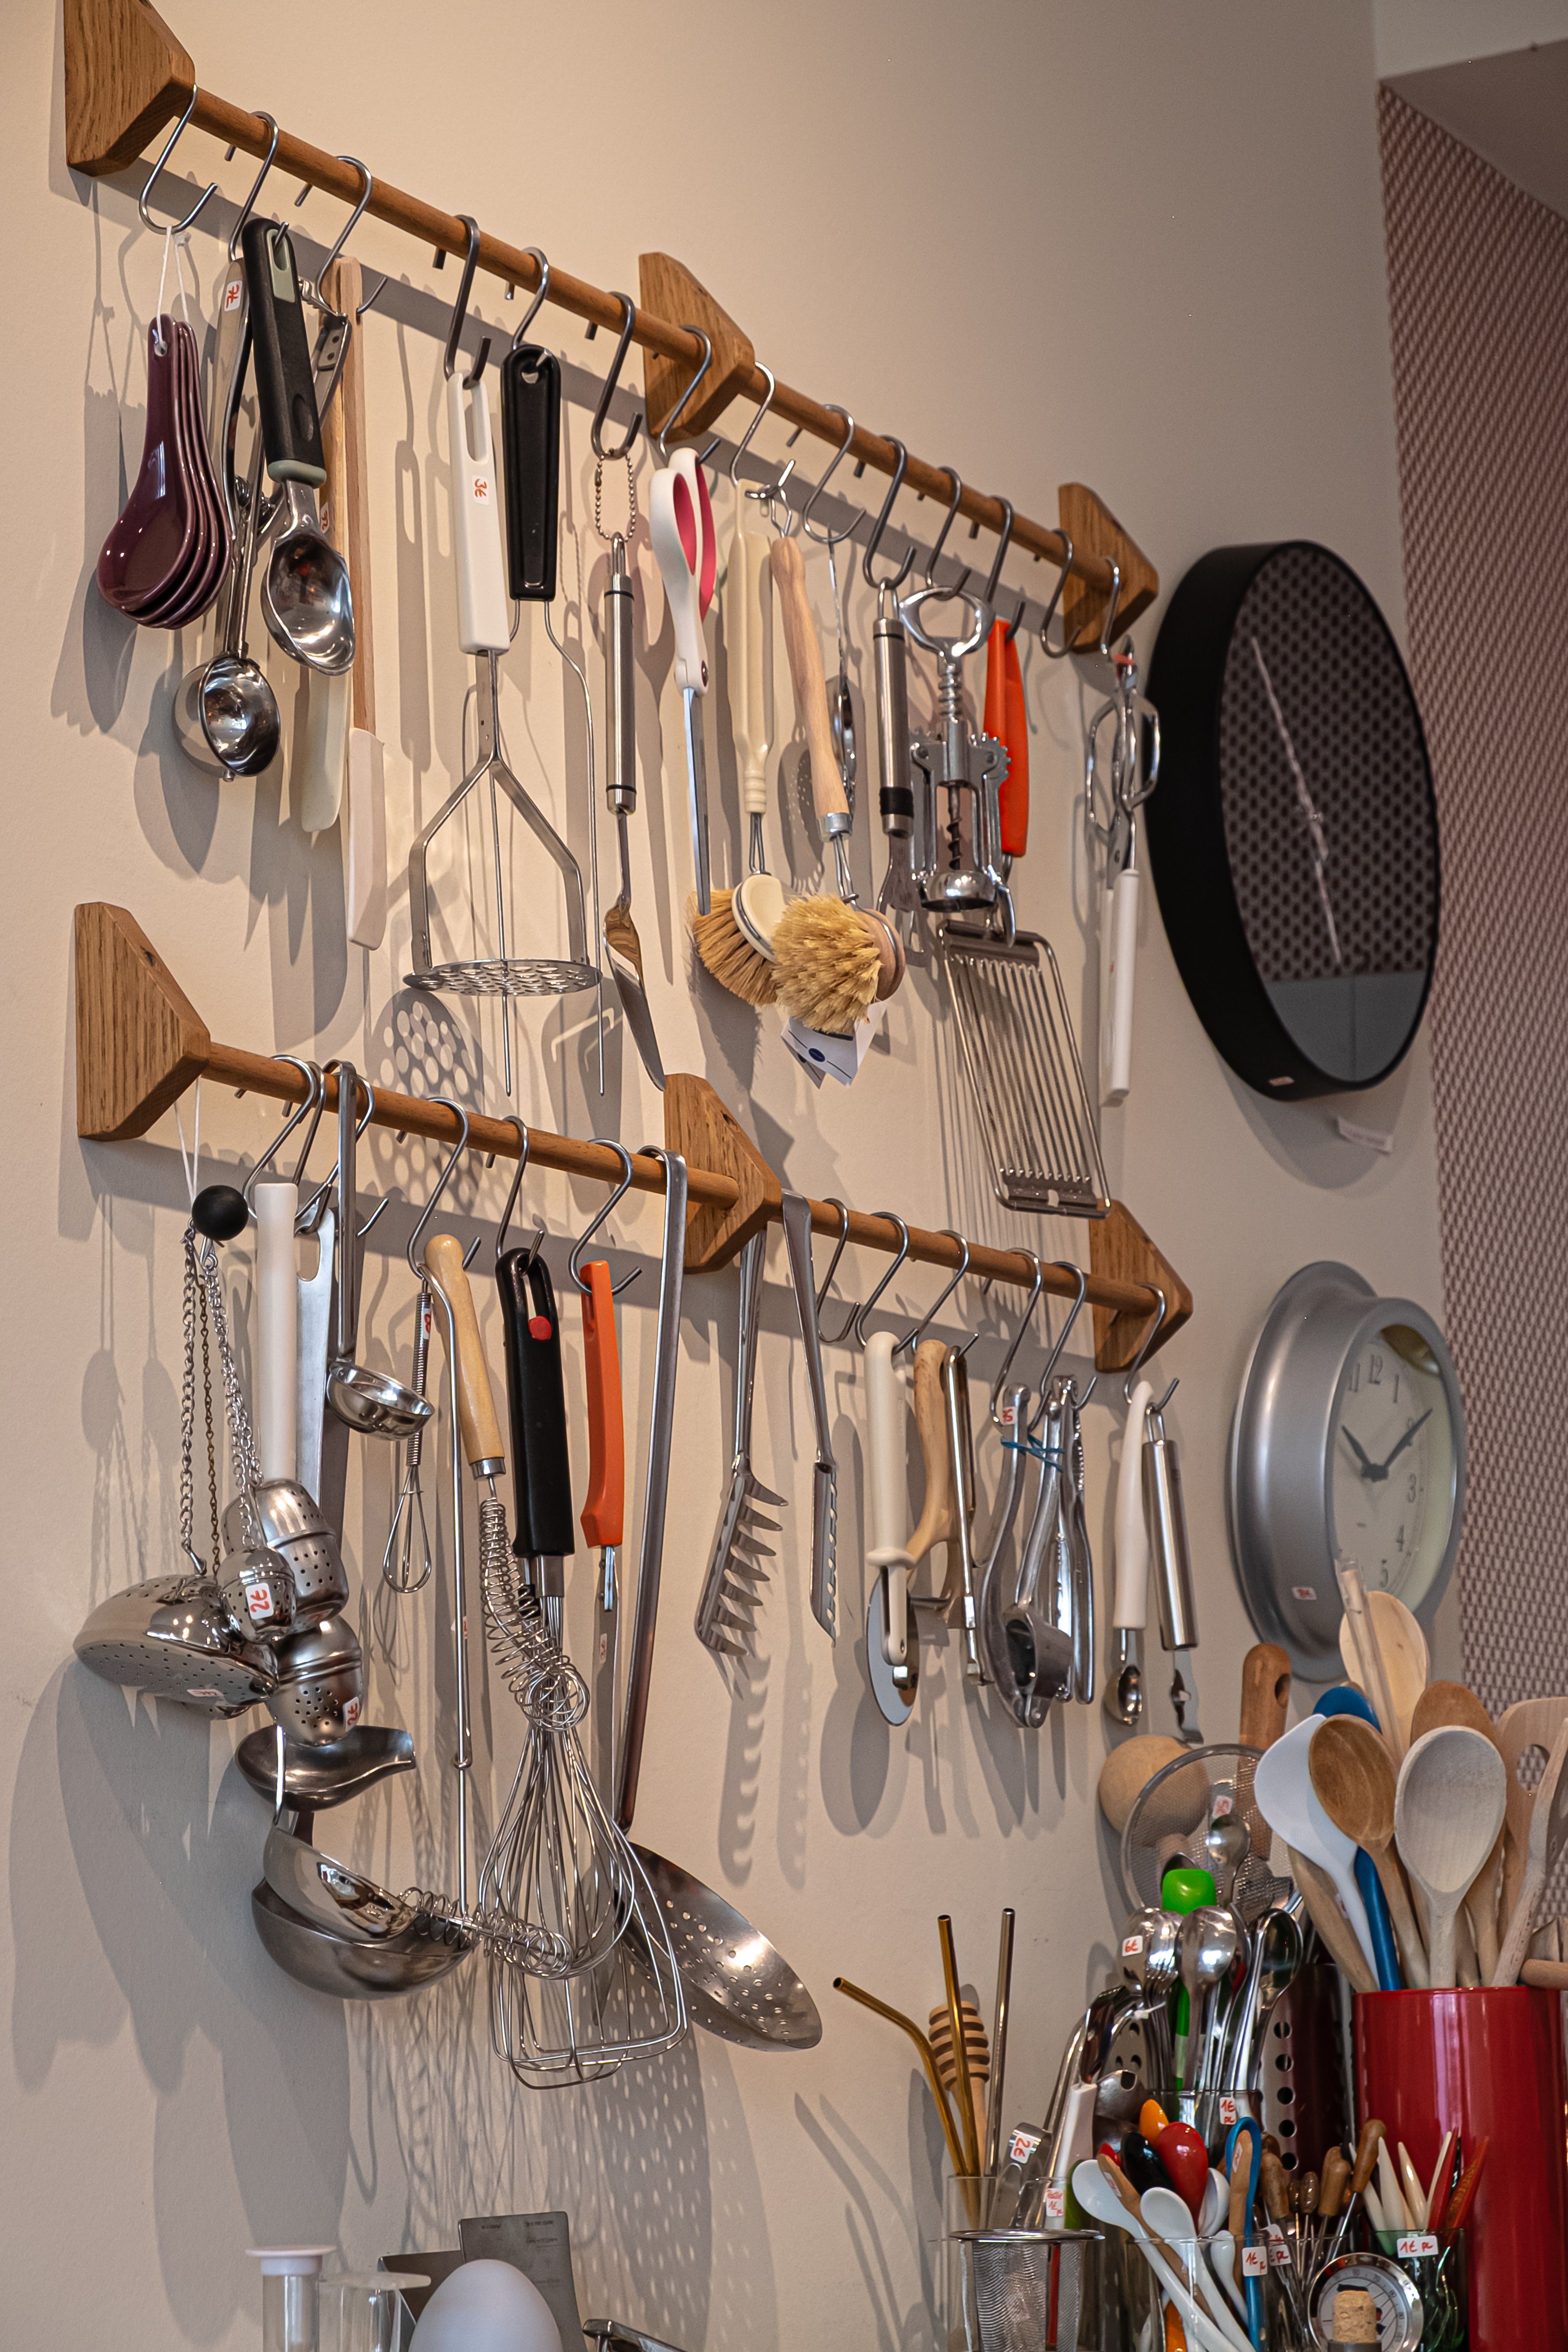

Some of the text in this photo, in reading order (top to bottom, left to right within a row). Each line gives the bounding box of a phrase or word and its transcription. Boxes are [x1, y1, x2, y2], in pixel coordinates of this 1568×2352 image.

[474, 478, 487, 497] 3€
[1348, 1363, 1361, 1392] 11
[1368, 1354, 1383, 1384] 12
[1393, 1374, 1400, 1403] 1
[1408, 1471, 1417, 1504] 3
[1396, 1525, 1405, 1552] 4
[1380, 1559, 1389, 1588] 5
[250, 1589, 270, 1613] 2€
[347, 1703, 358, 1726] 2€
[1221, 2099, 1236, 2113] 1€
[1014, 2137, 1031, 2157] 2€
[1246, 2252, 1259, 2266] 1€
[1400, 2240, 1418, 2254] 1€
